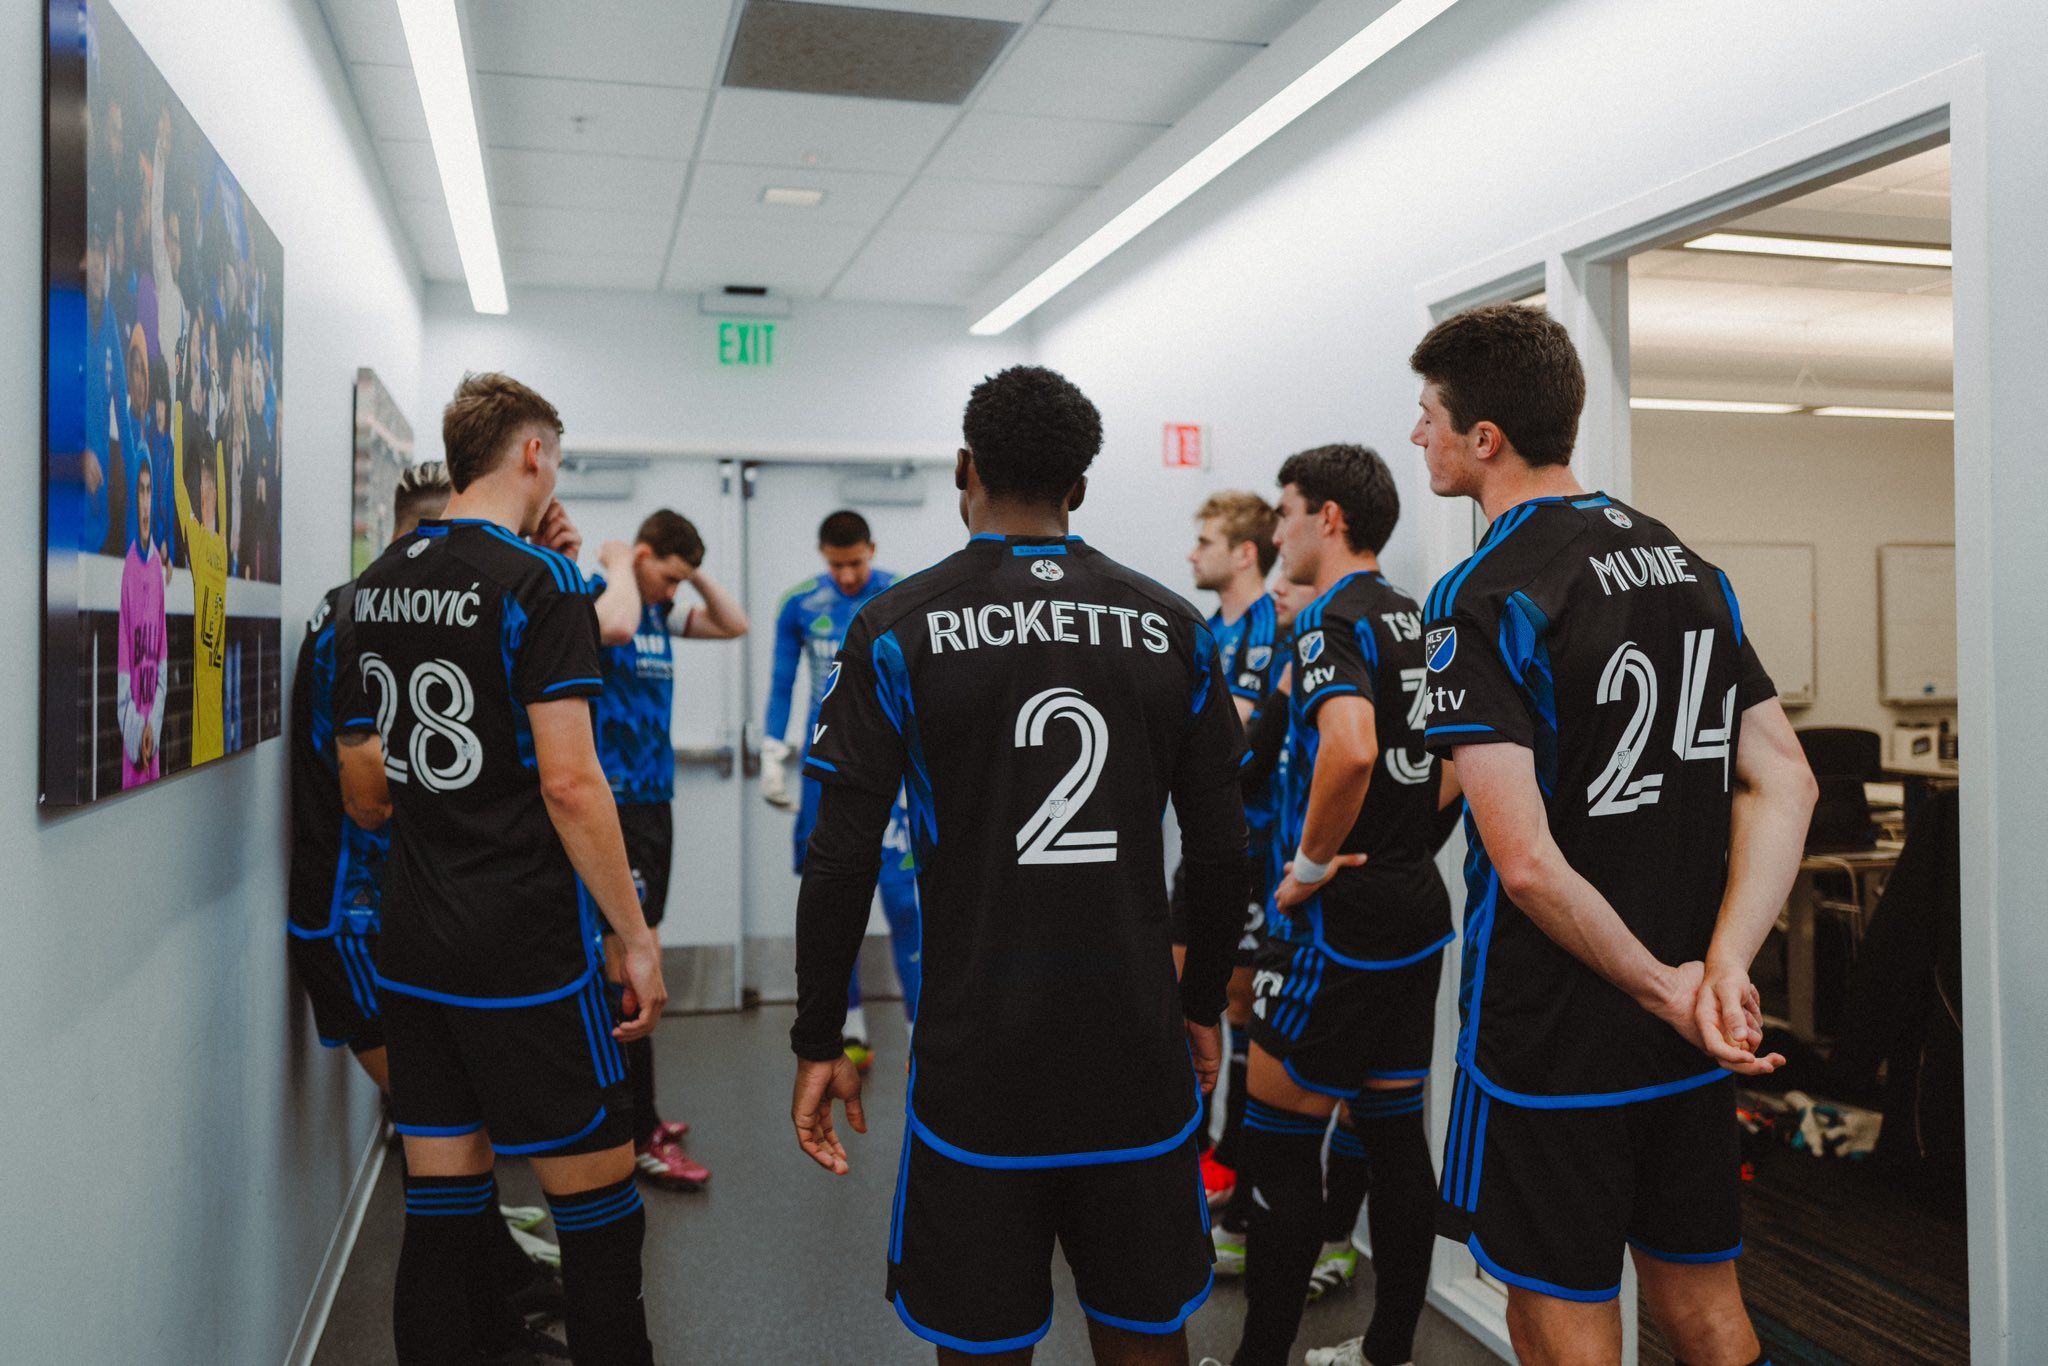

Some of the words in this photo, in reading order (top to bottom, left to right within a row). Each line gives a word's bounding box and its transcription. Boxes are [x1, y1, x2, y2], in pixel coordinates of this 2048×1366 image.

[719, 322, 775, 365] EXIT
[1589, 545, 1698, 596] MUNIE
[926, 600, 1169, 655] RICKETTS
[358, 651, 484, 794] 28
[1435, 686, 1466, 712] tv
[1587, 628, 1738, 818] 24
[1014, 687, 1118, 865] 2
